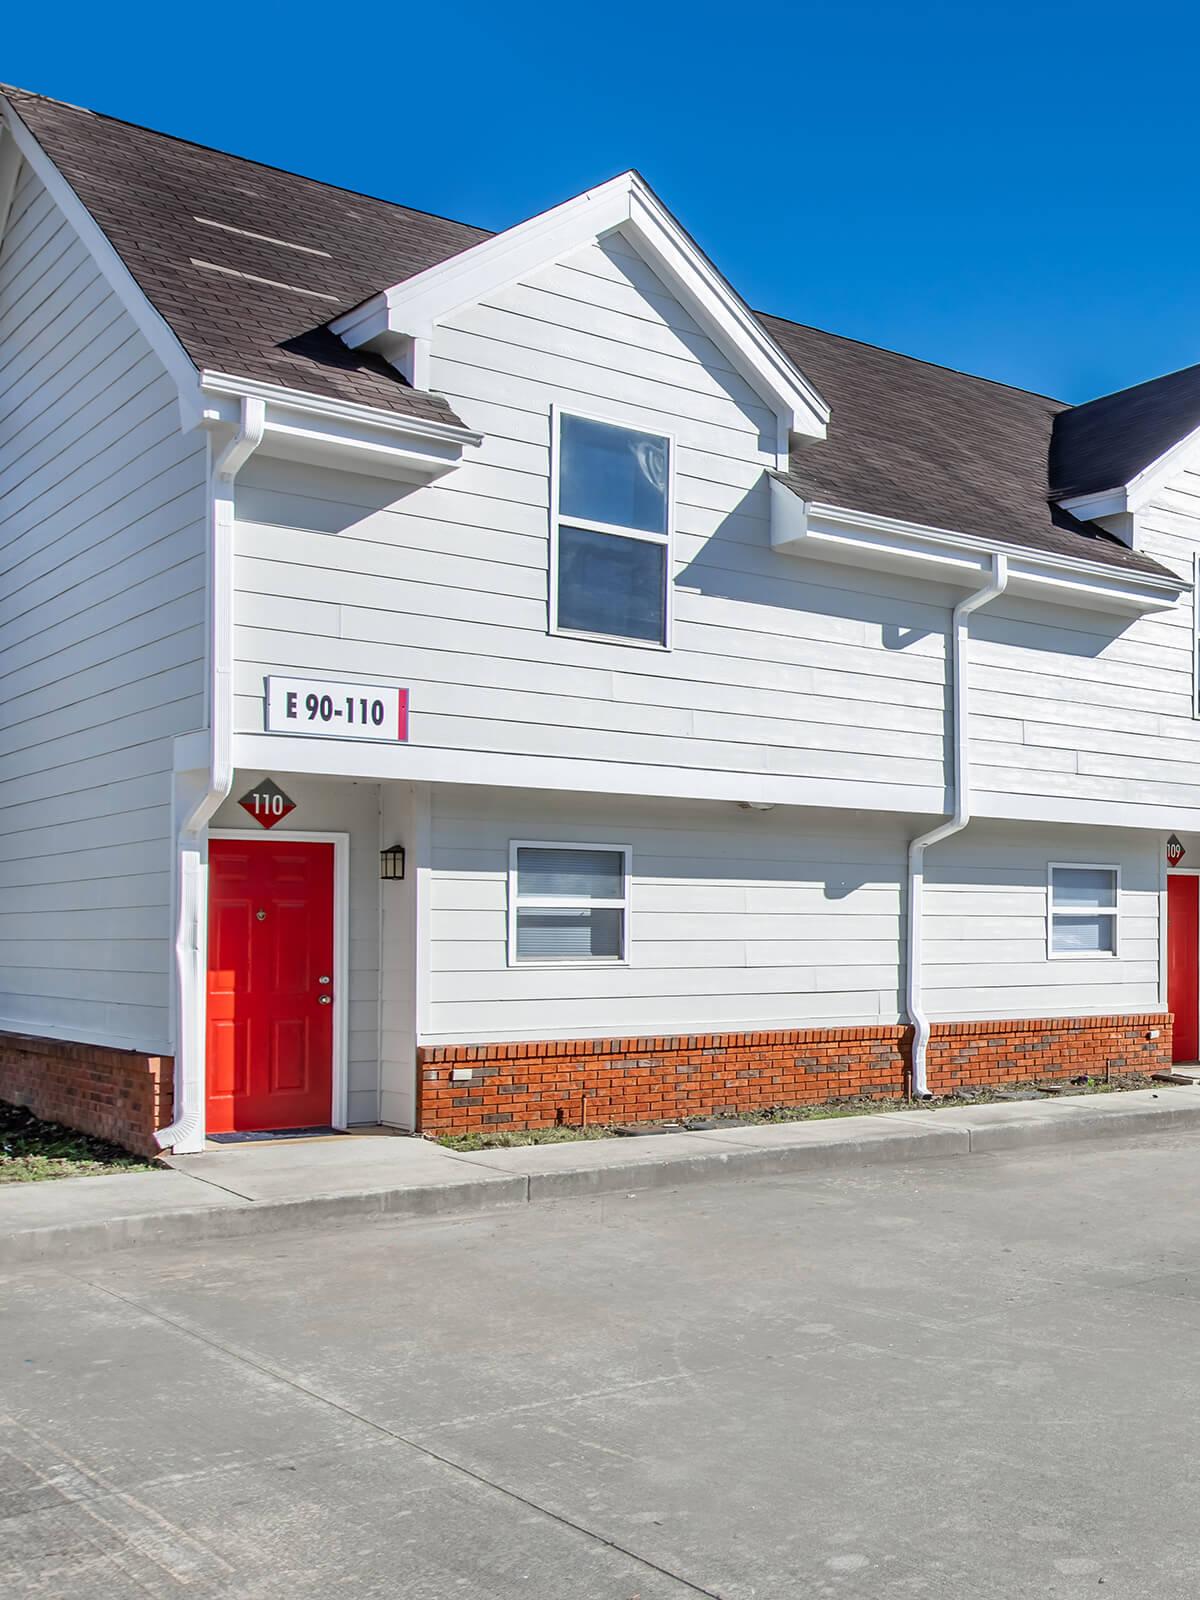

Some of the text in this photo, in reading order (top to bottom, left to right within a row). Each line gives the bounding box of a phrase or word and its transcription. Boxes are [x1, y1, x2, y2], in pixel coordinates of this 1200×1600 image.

[286, 692, 385, 726] E 90-110
[252, 793, 284, 816] 110
[1167, 843, 1181, 858] 109
